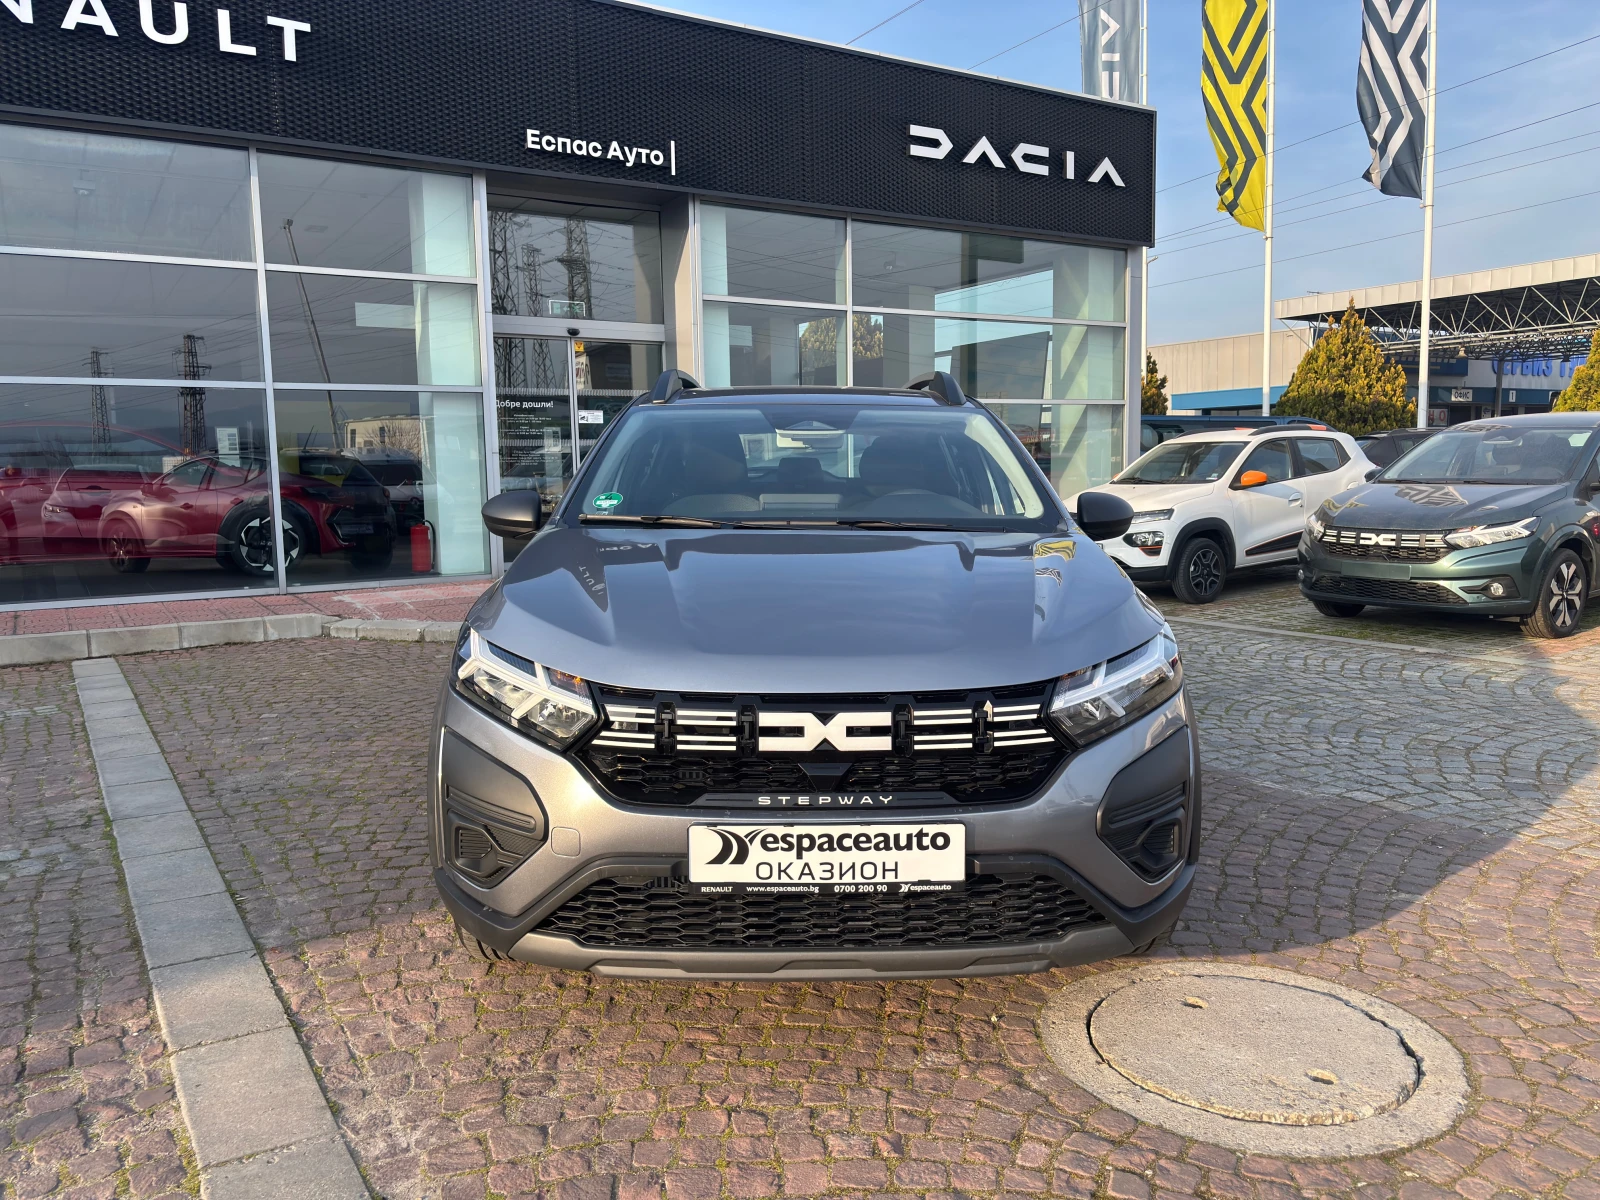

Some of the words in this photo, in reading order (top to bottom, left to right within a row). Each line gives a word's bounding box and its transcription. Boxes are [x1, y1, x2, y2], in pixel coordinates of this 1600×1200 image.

[526, 128, 603, 158] Еспас
[606, 140, 664, 167] Ауто
[907, 124, 1126, 187] DACIA
[522, 401, 554, 409] дошли!
[757, 795, 893, 806] STEPWAY
[759, 827, 951, 860] espaceauto
[755, 861, 898, 881] ОКАЗИОН
[746, 885, 820, 894] www.espaceauto.bg
[834, 885, 856, 893] 0700
[857, 885, 874, 893] 200
[876, 884, 888, 893] 90
[910, 883, 952, 892] espaceauto
